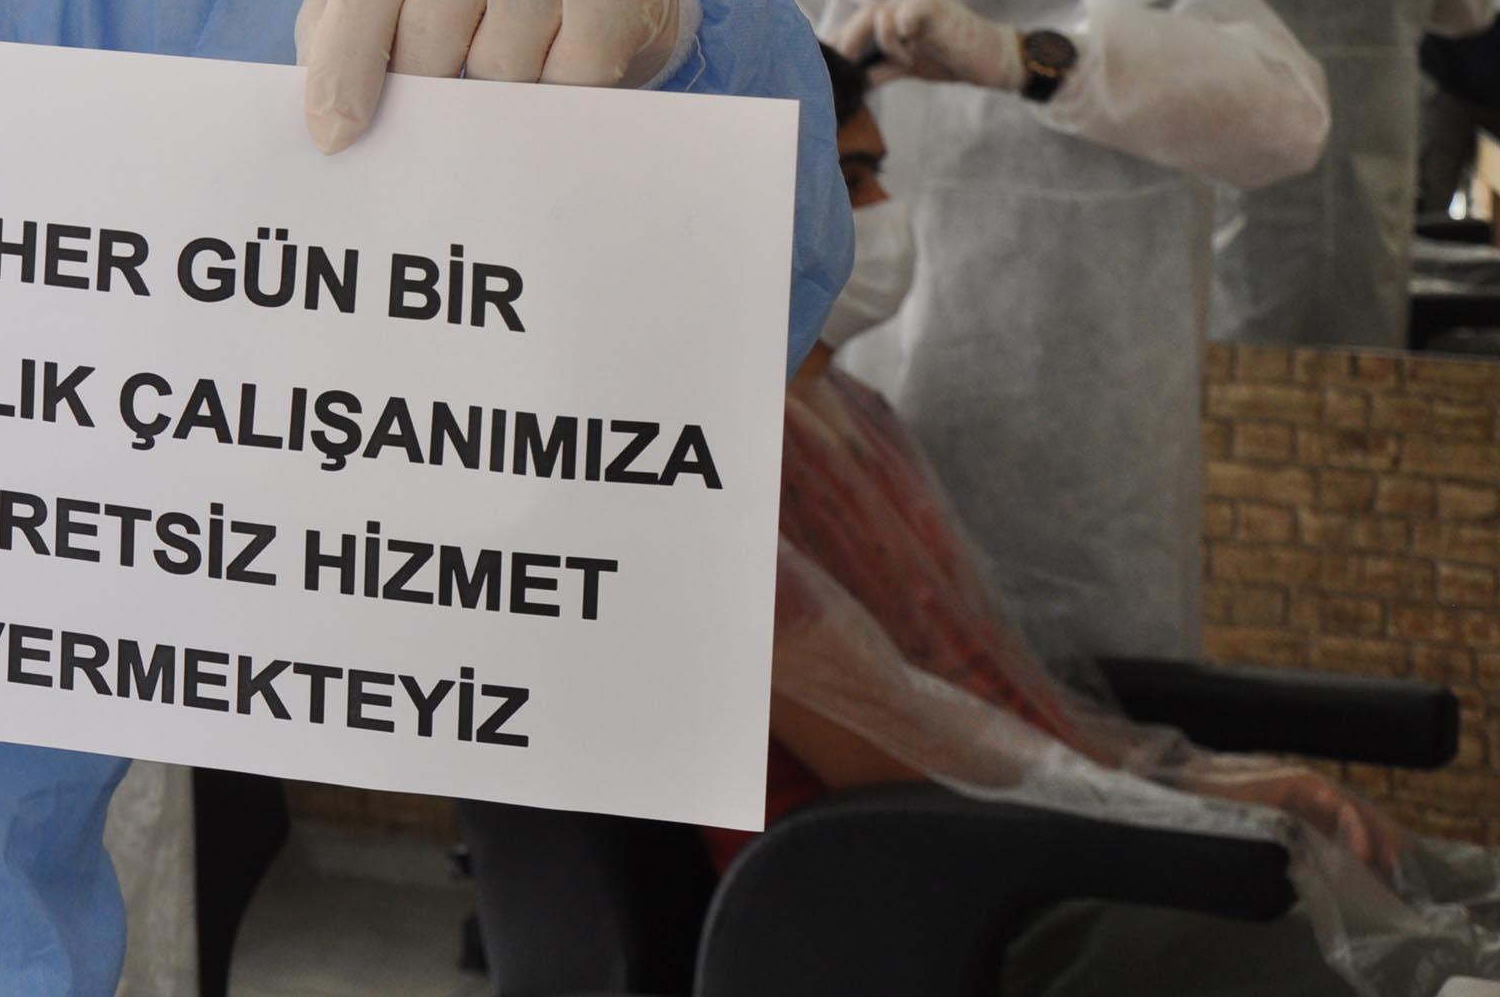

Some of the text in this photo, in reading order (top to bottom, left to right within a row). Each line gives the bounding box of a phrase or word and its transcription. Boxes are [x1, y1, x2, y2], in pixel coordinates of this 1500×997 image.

[177, 226, 359, 314] GÜN
[388, 243, 526, 333] BİR
[119, 372, 723, 490] ÇALIŞANIMIZA
[304, 520, 619, 621] HİZMET
